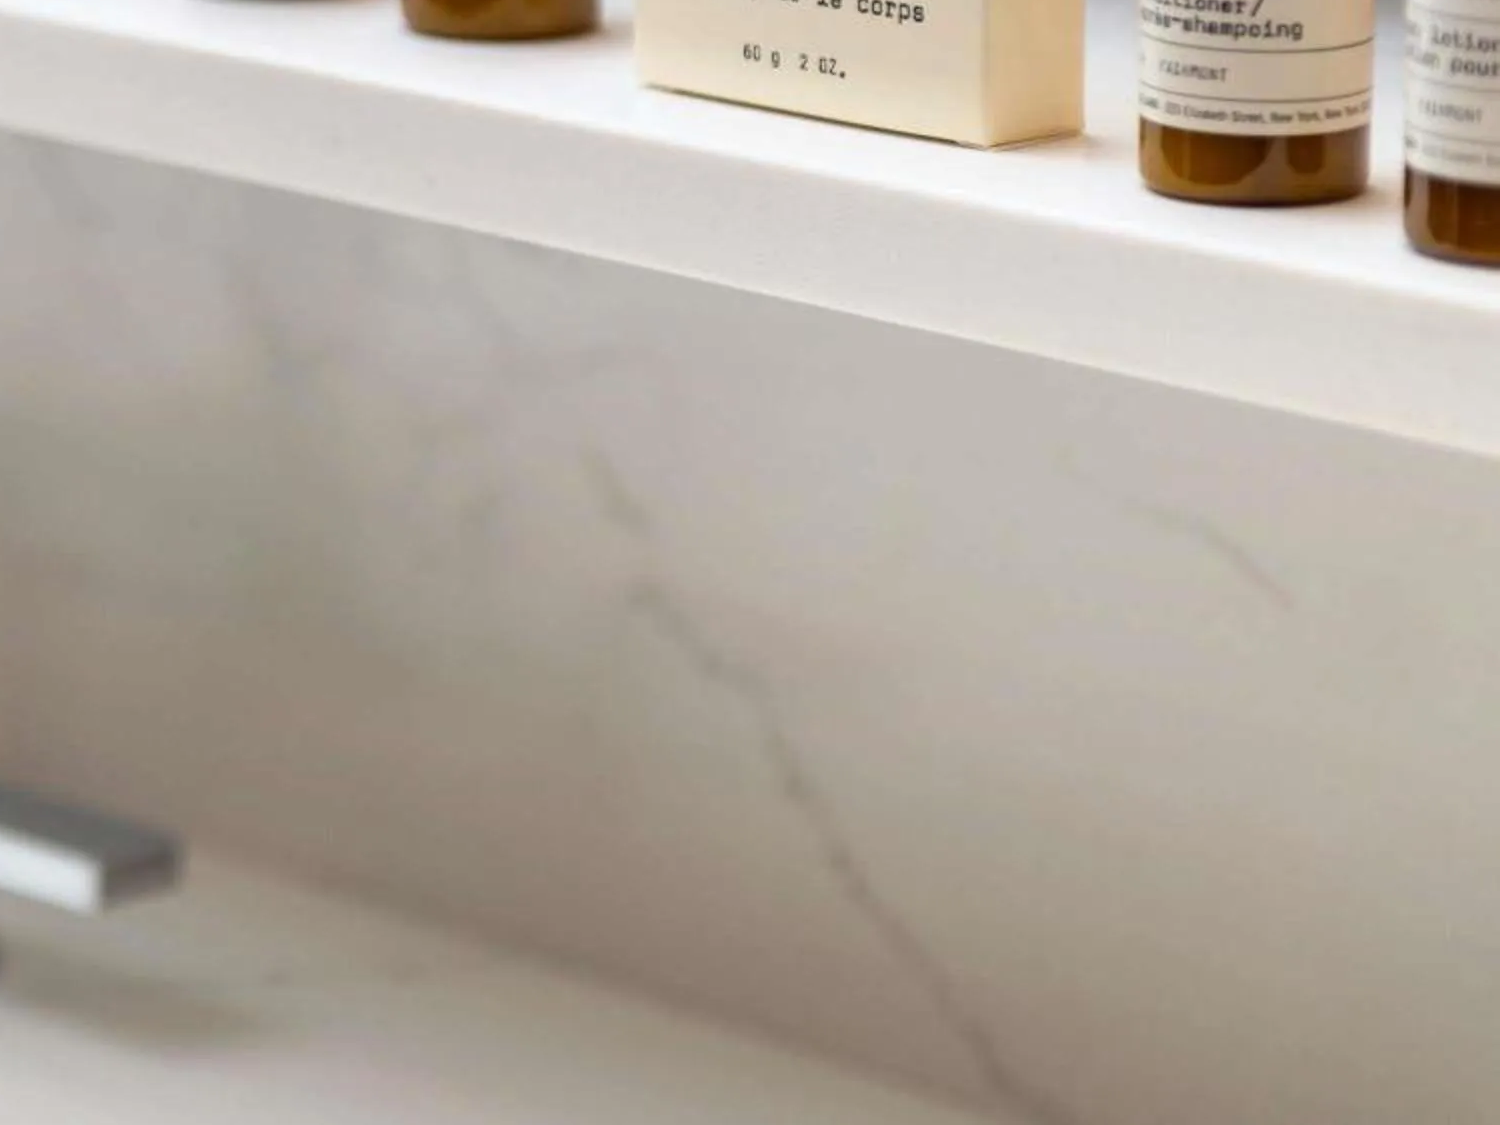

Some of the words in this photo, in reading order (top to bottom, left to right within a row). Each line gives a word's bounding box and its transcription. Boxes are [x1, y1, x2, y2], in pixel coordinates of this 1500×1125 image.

[743, 43, 762, 62] 60
[770, 50, 781, 68] g
[799, 53, 809, 72] 2
